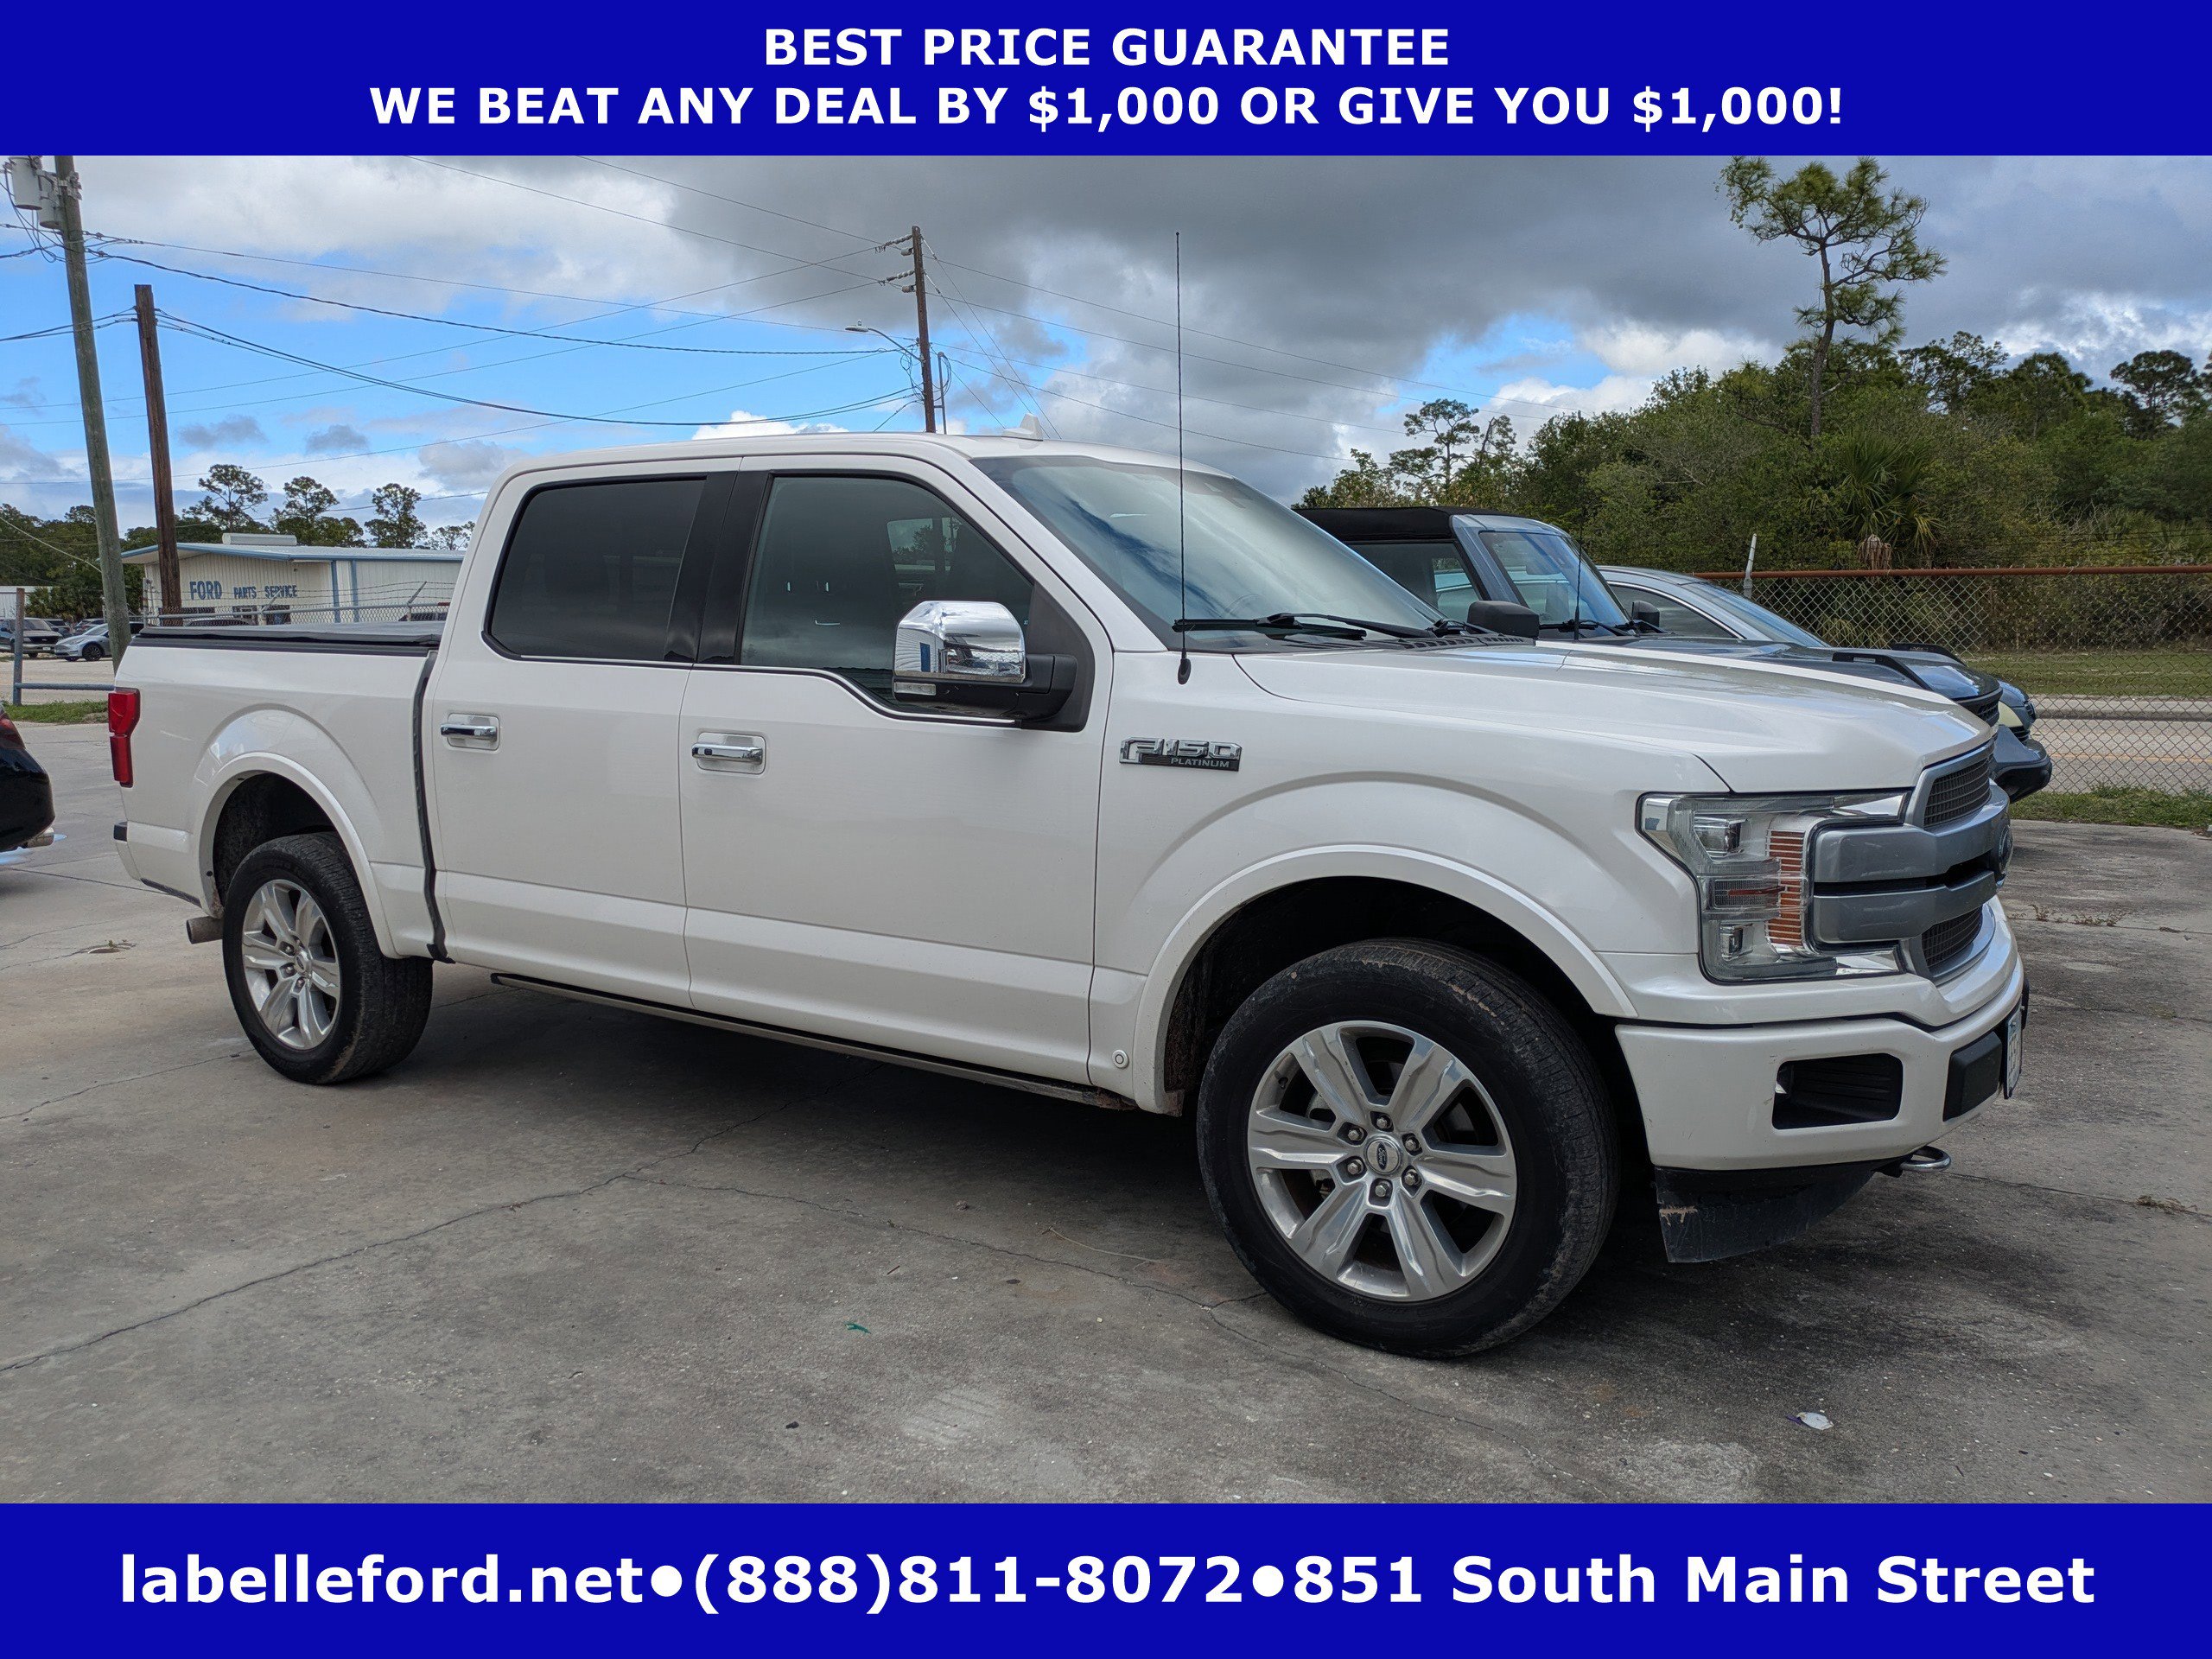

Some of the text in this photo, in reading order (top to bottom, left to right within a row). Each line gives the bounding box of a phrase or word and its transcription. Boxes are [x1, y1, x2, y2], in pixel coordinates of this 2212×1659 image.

[189, 580, 298, 601] FORD PARTS SERVICE
[1171, 758, 1230, 768] PLATINUM
